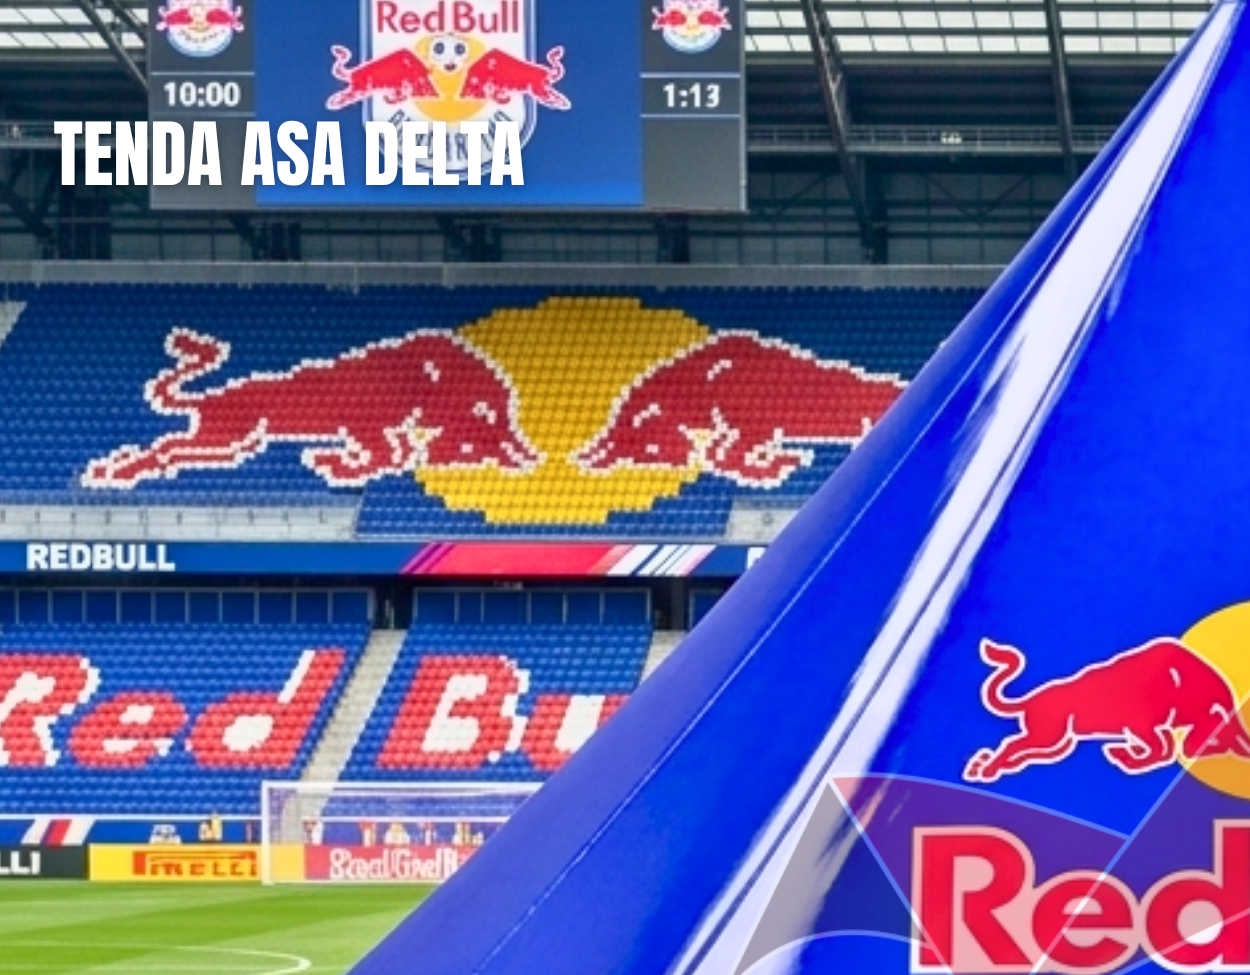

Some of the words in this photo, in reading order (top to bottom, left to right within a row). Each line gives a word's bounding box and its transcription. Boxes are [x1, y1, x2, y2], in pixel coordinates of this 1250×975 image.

[377, 0, 444, 33] Red
[453, 0, 518, 33] Bull
[164, 82, 240, 107] 10:00
[663, 83, 720, 108] 1:13
[27, 544, 175, 571] REDBULL
[0, 648, 346, 769] Red
